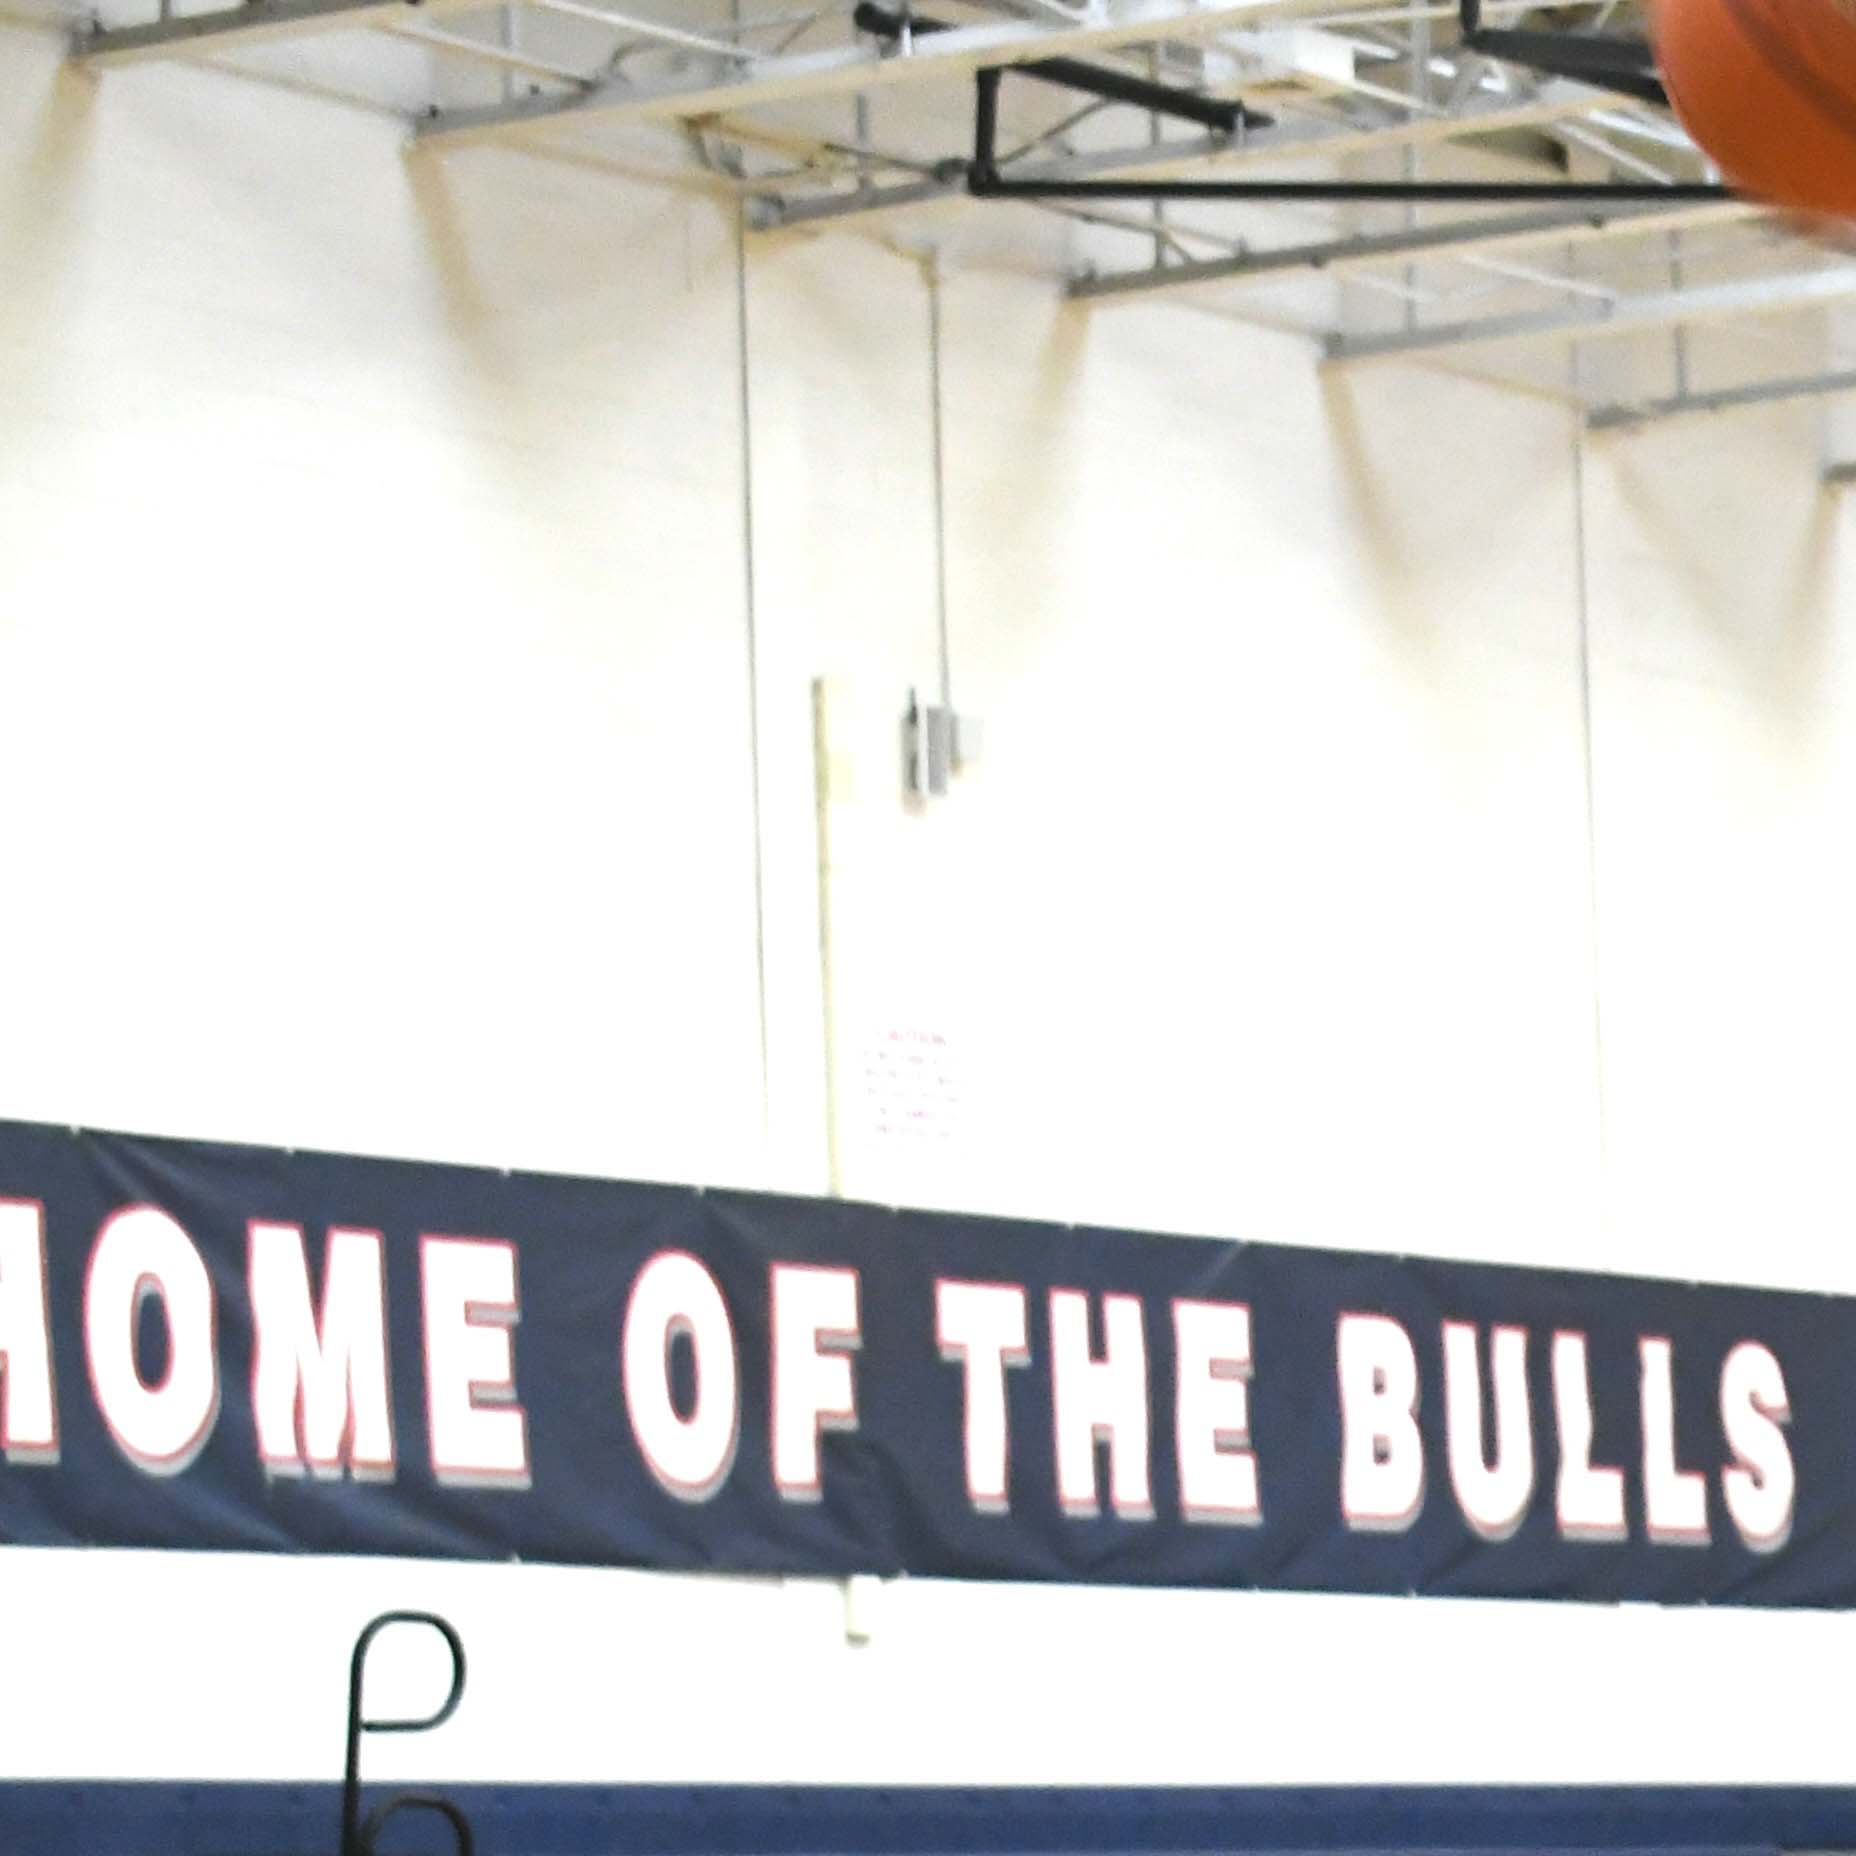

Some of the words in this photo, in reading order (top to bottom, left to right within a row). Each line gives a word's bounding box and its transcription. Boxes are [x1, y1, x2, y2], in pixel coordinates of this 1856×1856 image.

[622, 1247, 863, 1505] OF
[933, 1277, 1265, 1527] THE
[1335, 1310, 1798, 1554] BULLS
